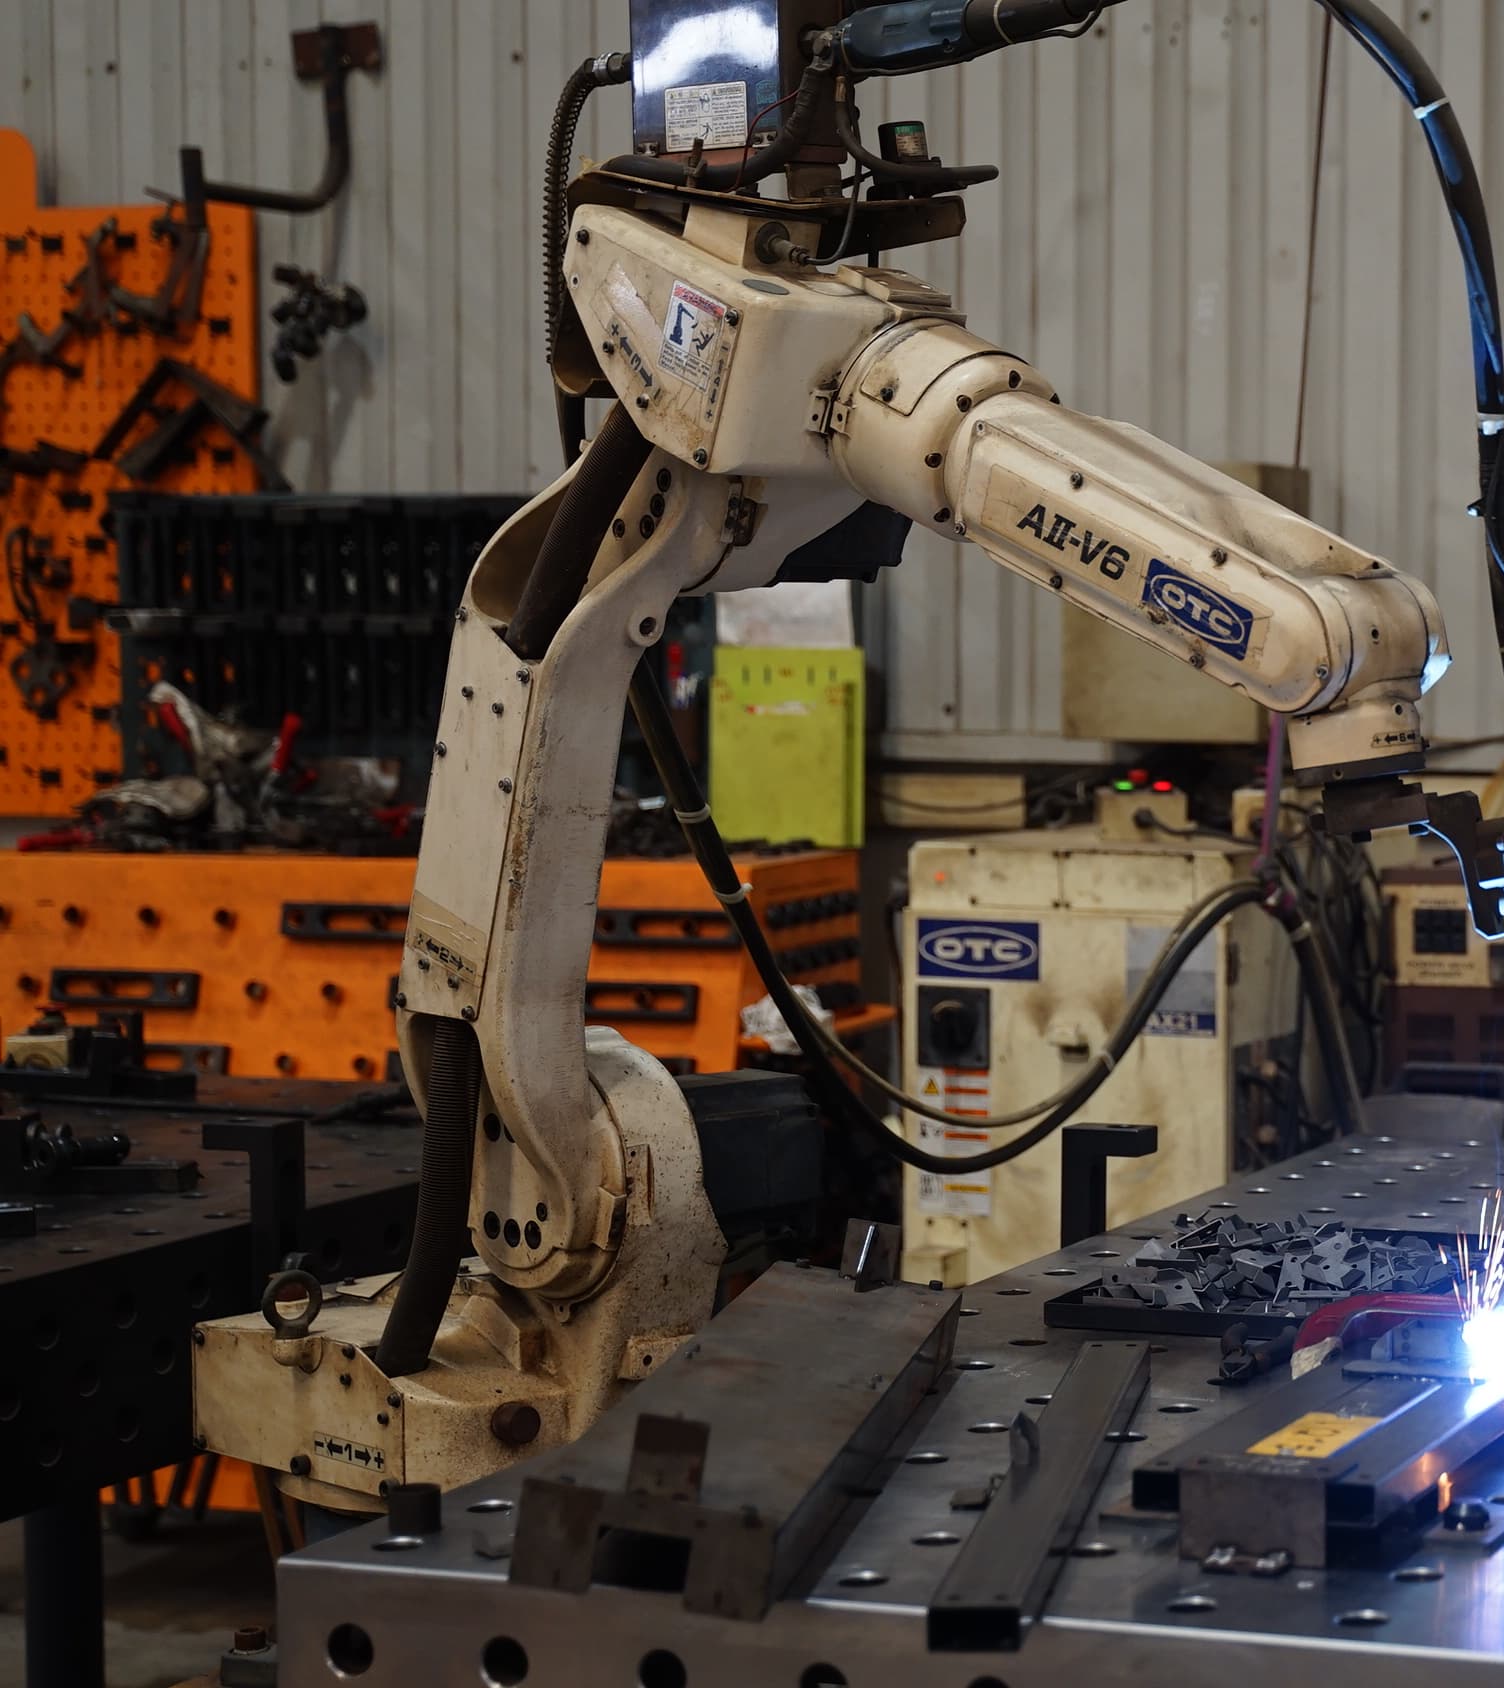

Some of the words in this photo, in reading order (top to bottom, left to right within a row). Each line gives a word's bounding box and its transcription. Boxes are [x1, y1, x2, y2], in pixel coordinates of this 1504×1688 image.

[1161, 582, 1237, 637] OTC
[932, 936, 1024, 963] OTC
[344, 1443, 353, 1462] 1
